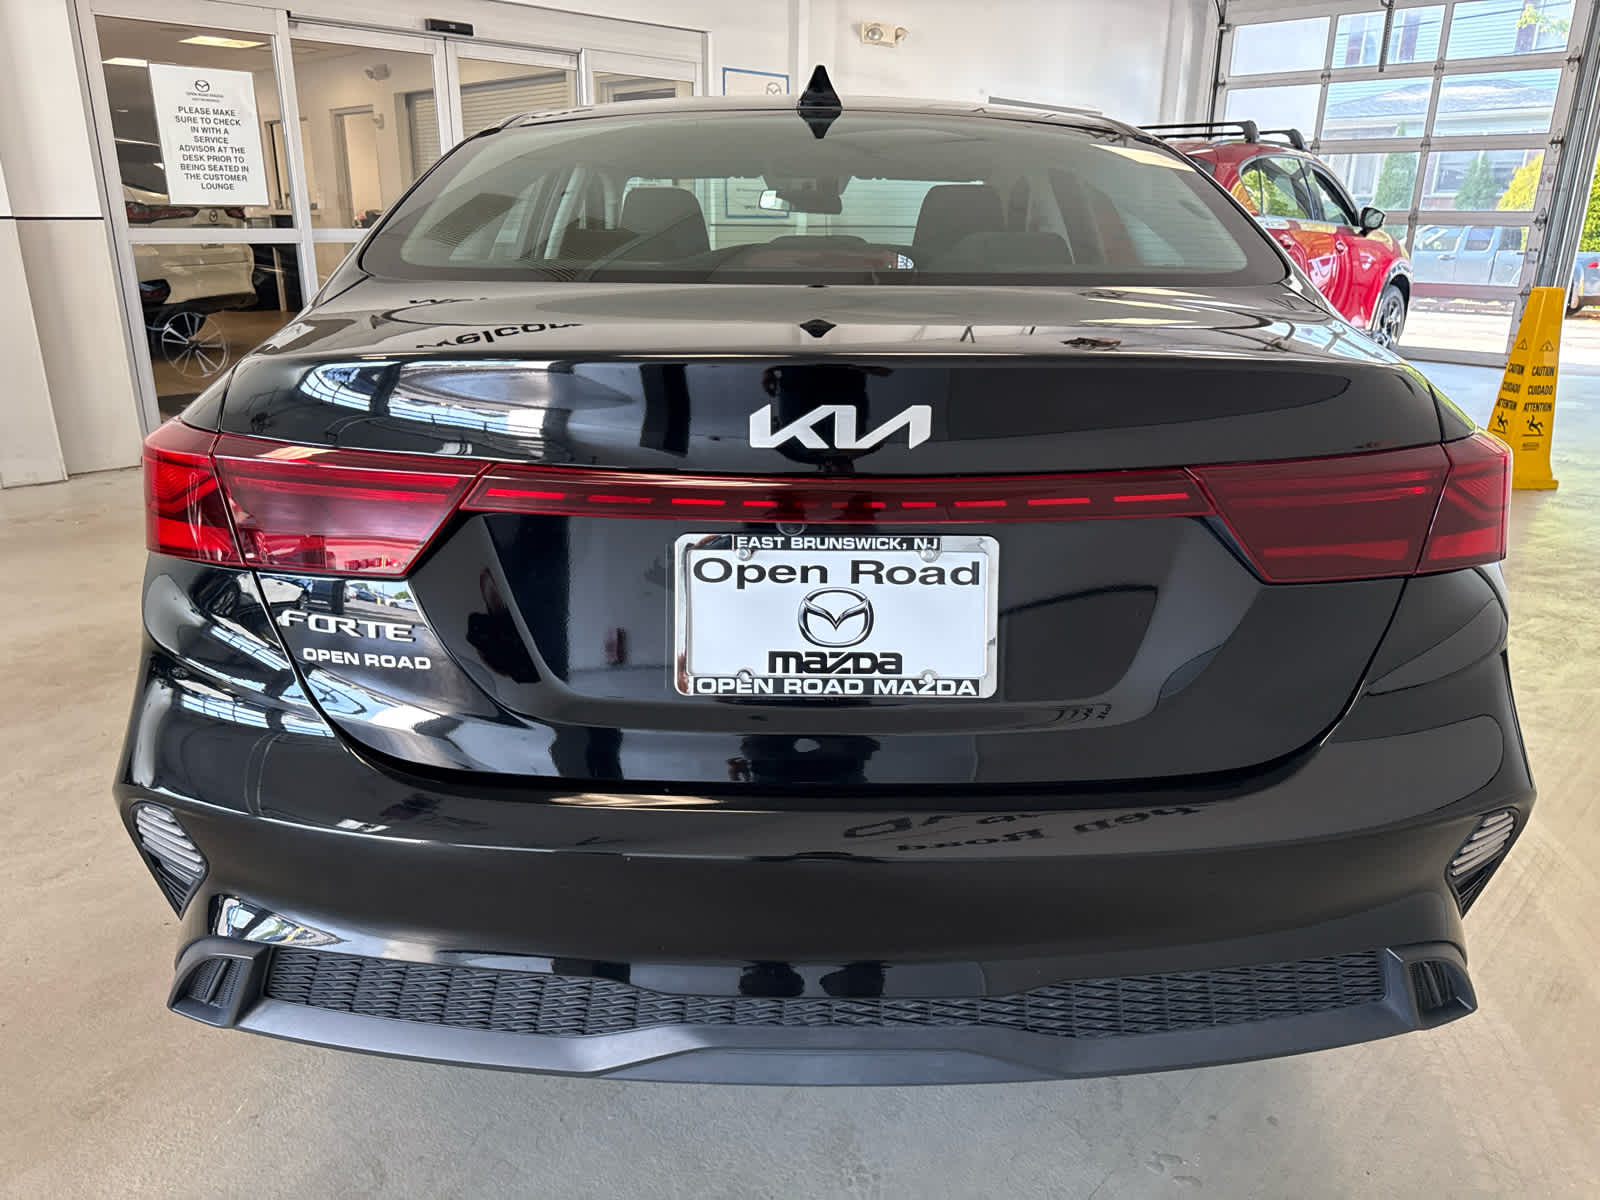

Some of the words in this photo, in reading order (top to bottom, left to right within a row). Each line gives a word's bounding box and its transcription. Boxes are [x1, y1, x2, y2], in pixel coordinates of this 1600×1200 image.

[178, 106, 210, 114] PLEASE
[1532, 367, 1554, 376] CAUTION
[1528, 385, 1552, 394] CUIDADO
[1524, 403, 1551, 411] ATTENTION
[750, 404, 931, 449] KIA
[736, 536, 785, 549] EAST
[791, 537, 907, 550] BRUNSWICK,
[914, 537, 938, 550] NJ
[693, 557, 828, 589] Open
[850, 559, 980, 585] Road
[276, 610, 417, 642] FORTE
[303, 648, 360, 665] OPEN
[364, 654, 431, 669] ROAD
[696, 677, 774, 694] OPEN
[784, 678, 864, 694] ROAD
[873, 679, 977, 695] MAZDA
